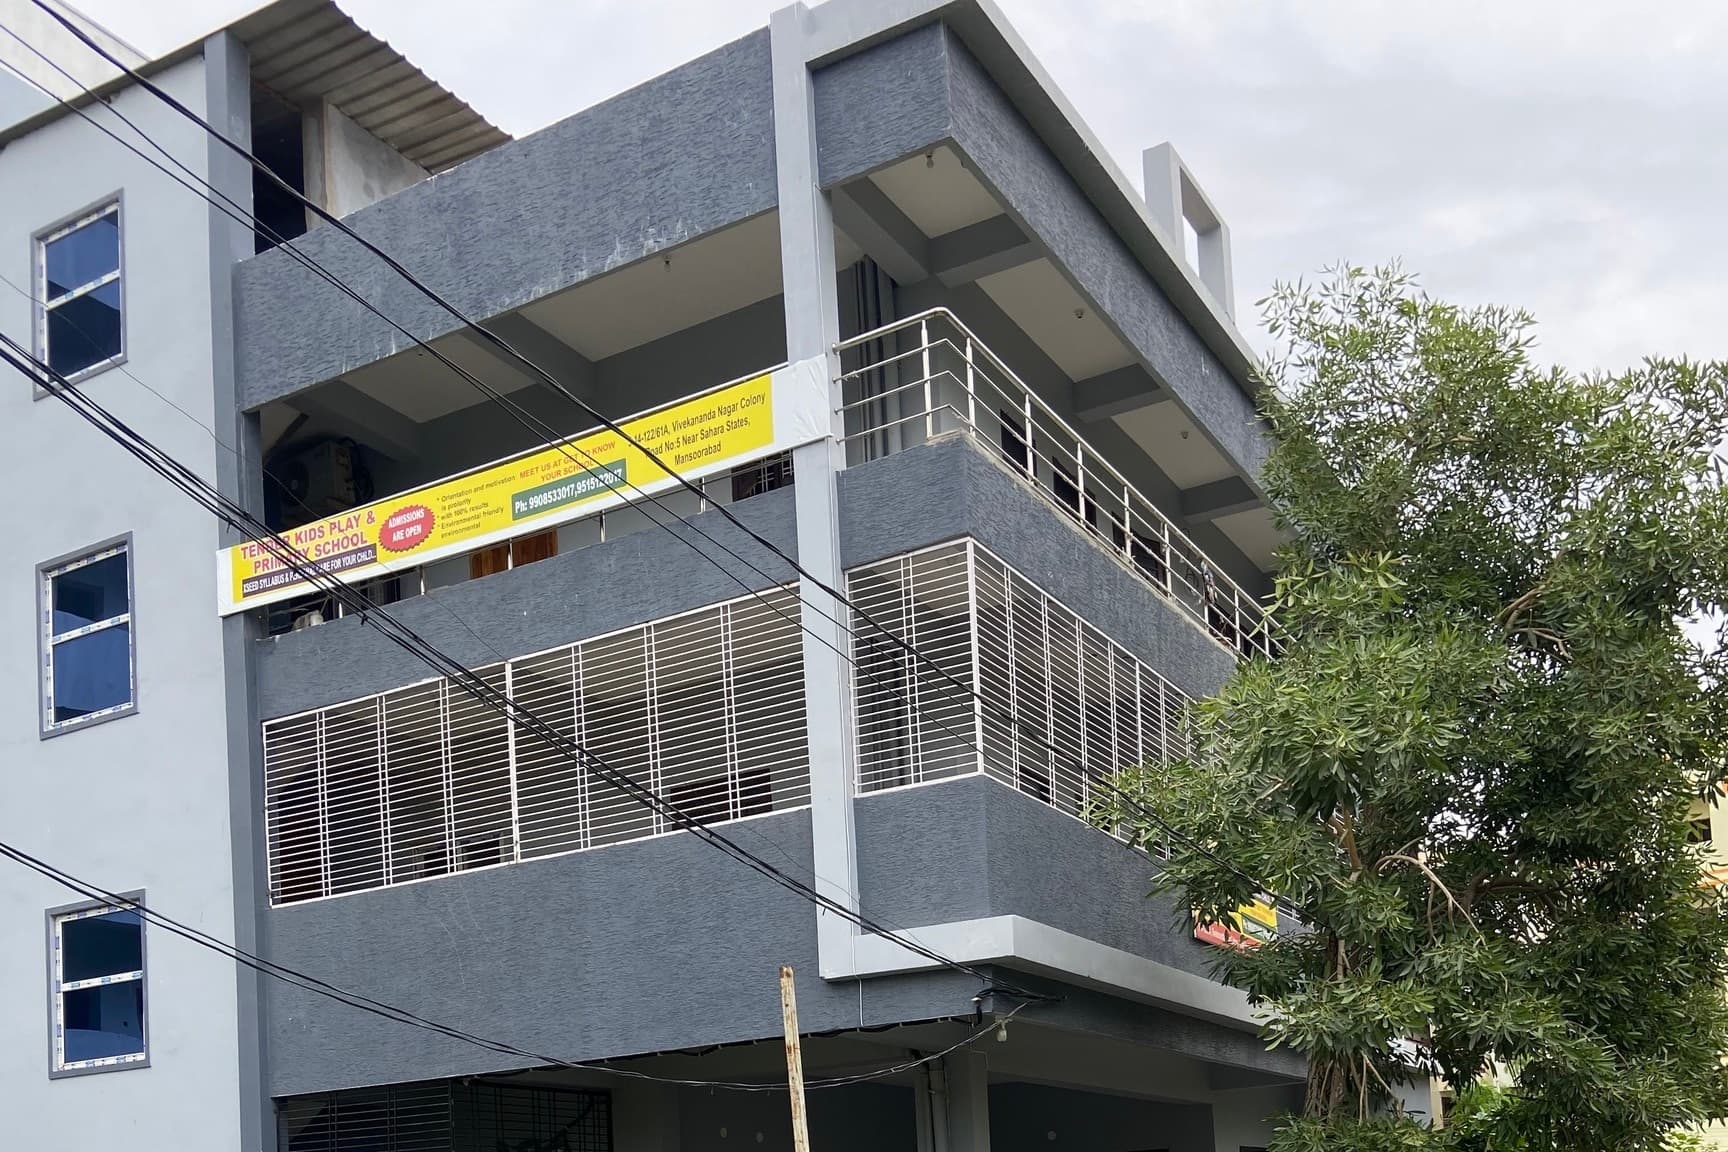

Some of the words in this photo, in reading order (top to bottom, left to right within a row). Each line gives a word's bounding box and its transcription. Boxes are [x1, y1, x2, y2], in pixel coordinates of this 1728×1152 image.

[672, 409, 717, 433] Vivekananda
[717, 402, 739, 418] Nagar
[740, 392, 766, 410] Colony
[664, 436, 681, 453] No:5
[682, 433, 699, 447] Near
[700, 424, 725, 441] Sahara
[519, 466, 540, 479] MEET
[541, 462, 551, 472] US
[553, 458, 563, 468] AT
[592, 441, 616, 455] KNOW
[674, 441, 722, 465] Mansoorabad
[541, 471, 562, 483] YOUR
[474, 484, 485, 494] and
[469, 502, 489, 512] results
[515, 500, 528, 514] Ph:
[295, 525, 325, 546] KIDS
[329, 514, 361, 536] PLAY
[366, 510, 375, 524] &
[388, 508, 425, 529] ADMISSIONS
[392, 530, 405, 542] ARE
[405, 524, 422, 539] OPEN
[315, 532, 367, 557] SCHOOL
[342, 553, 357, 567] YOUR
